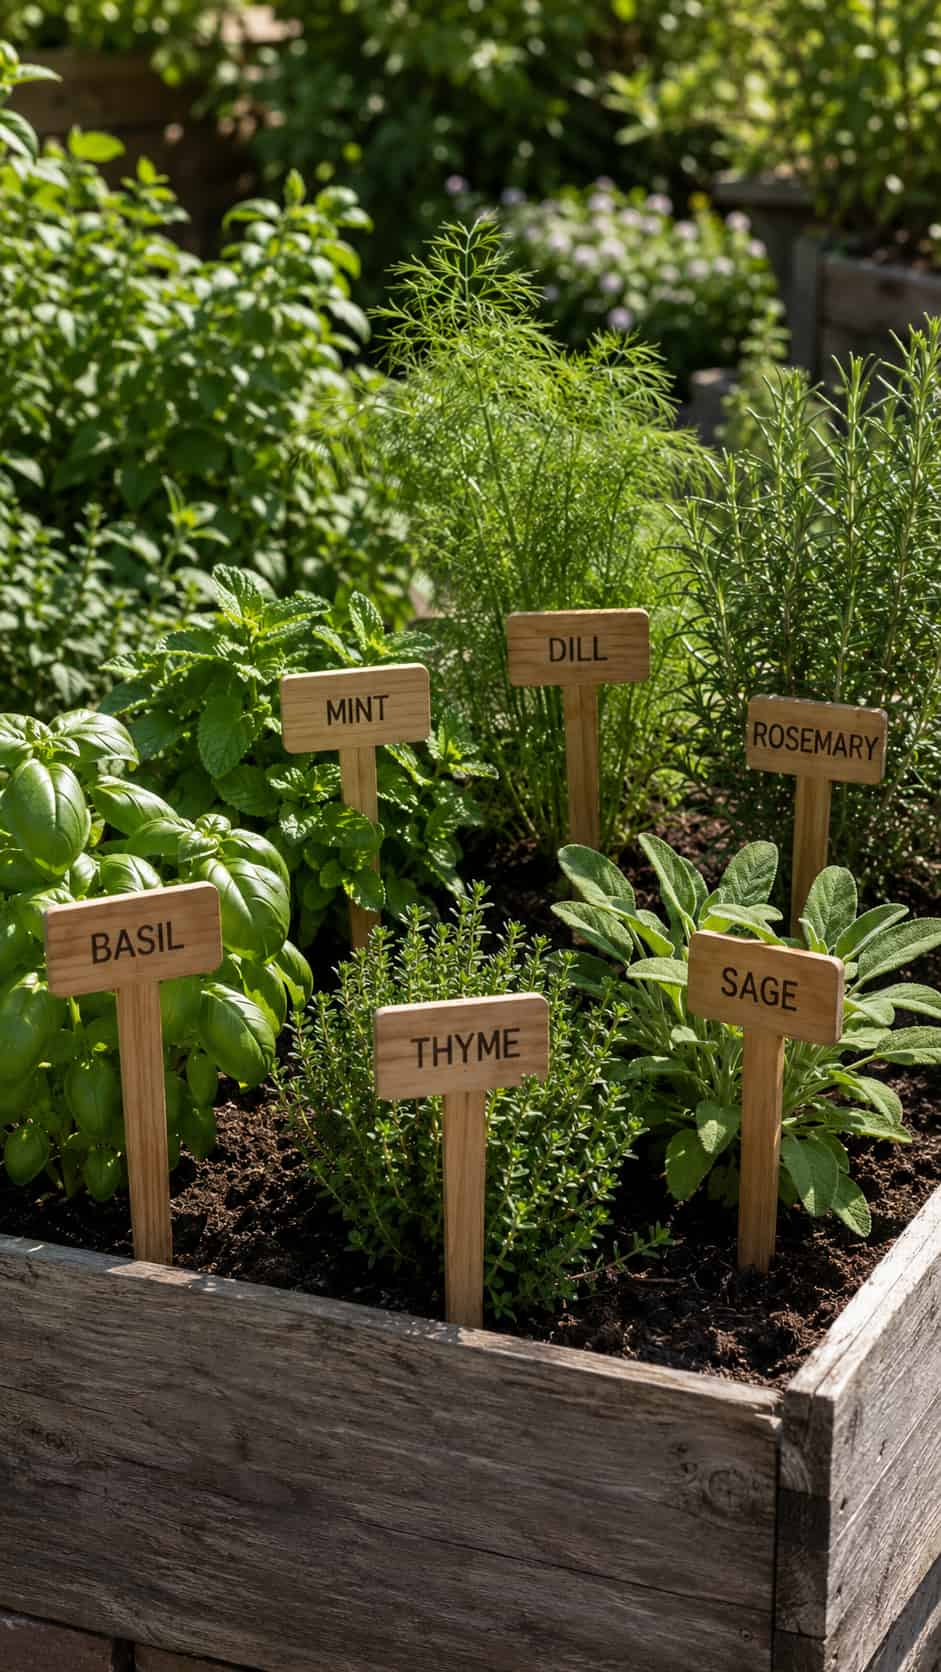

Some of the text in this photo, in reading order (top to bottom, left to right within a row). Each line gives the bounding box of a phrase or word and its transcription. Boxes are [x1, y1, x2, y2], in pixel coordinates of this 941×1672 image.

[549, 635, 608, 663] DILL
[327, 695, 390, 725] MINT
[753, 721, 880, 760] ROSEMARY
[91, 922, 185, 964] BASIL
[720, 966, 798, 1012] SAGE
[411, 1027, 521, 1068] THYME
